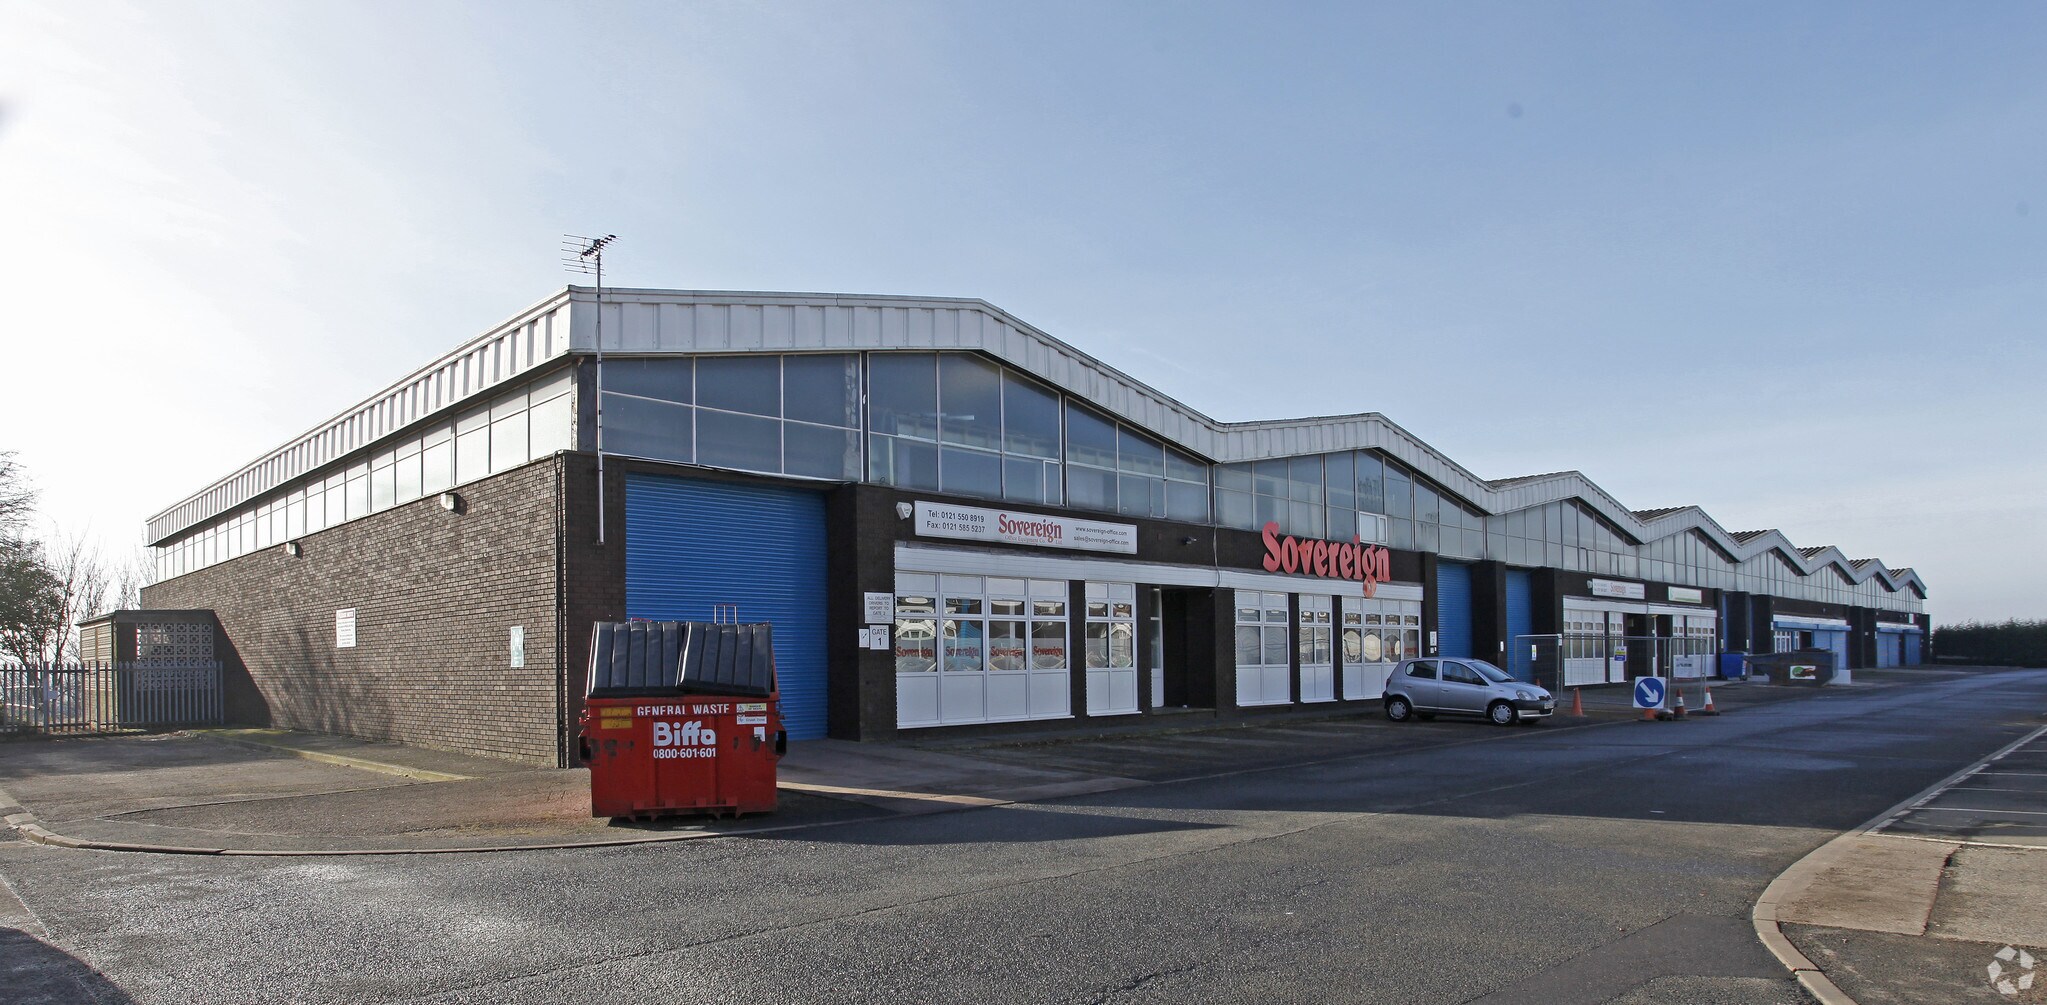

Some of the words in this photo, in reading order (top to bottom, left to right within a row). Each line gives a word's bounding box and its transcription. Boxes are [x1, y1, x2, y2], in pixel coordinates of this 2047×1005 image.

[928, 509, 940, 518] Tel:
[941, 511, 956, 520] 0121
[958, 513, 969, 521] 550
[970, 514, 985, 523] 8919
[926, 520, 941, 529] Fax:
[942, 522, 957, 530] 0121
[958, 524, 970, 532] 585
[971, 525, 985, 533] 5237
[998, 513, 1062, 543] Sovereign
[1075, 526, 1128, 536] www.sovereign-office.com
[1073, 536, 1130, 546] sales@sovereign-office.com
[1262, 521, 1390, 598] Sovereign
[878, 637, 882, 646] 1
[896, 646, 933, 659] Sovereign
[945, 646, 979, 659] Sovereign
[990, 646, 1023, 659] Sovereign
[1033, 645, 1063, 657] Sovereign
[637, 705, 686, 716] GENERAL
[692, 703, 730, 715] WASTE
[653, 720, 716, 747] Biffa
